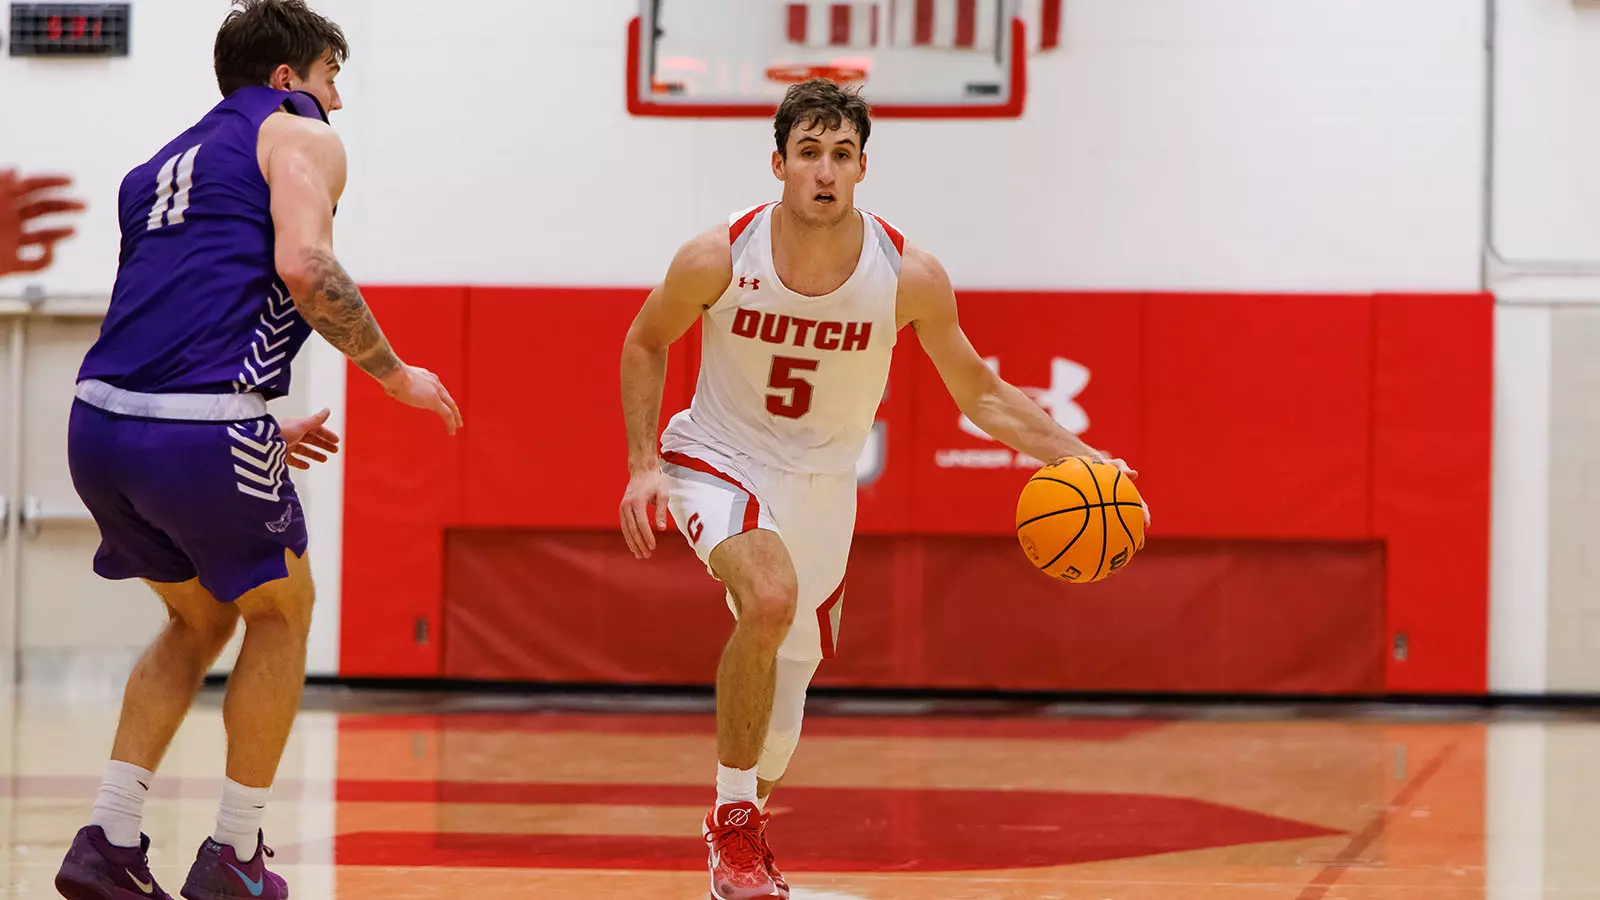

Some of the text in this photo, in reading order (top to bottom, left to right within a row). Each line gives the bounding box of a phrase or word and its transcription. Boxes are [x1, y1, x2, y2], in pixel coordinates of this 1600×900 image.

[146, 143, 202, 231] 11
[731, 307, 873, 351] DUTCH
[765, 354, 821, 420] 5
